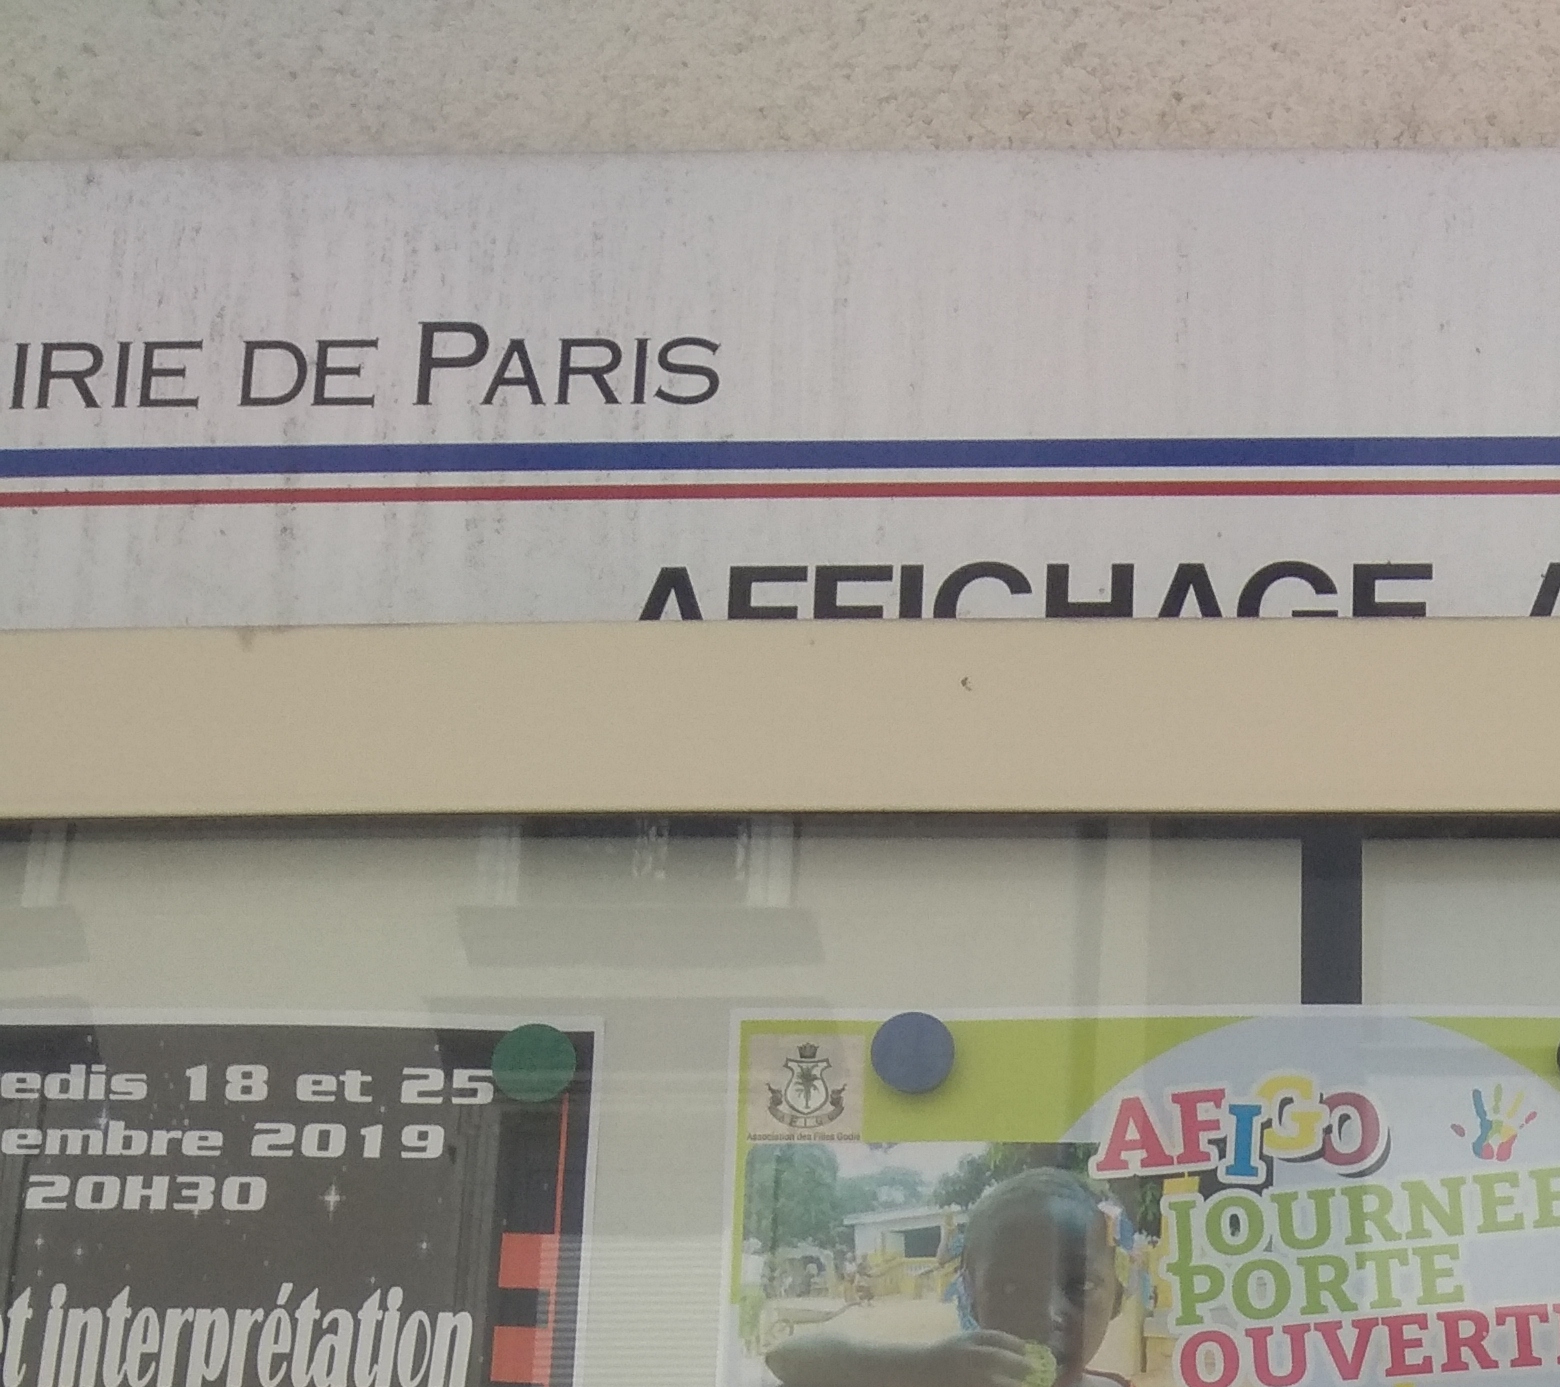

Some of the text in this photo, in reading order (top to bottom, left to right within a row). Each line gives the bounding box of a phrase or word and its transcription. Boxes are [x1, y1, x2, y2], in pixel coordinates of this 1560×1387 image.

[239, 338, 379, 408] DE
[186, 1065, 494, 1105] 18 25
[0, 1121, 445, 1159] embre 2019
[25, 1175, 267, 1211] 20H30
[1167, 1243, 1464, 1326] PORTE
